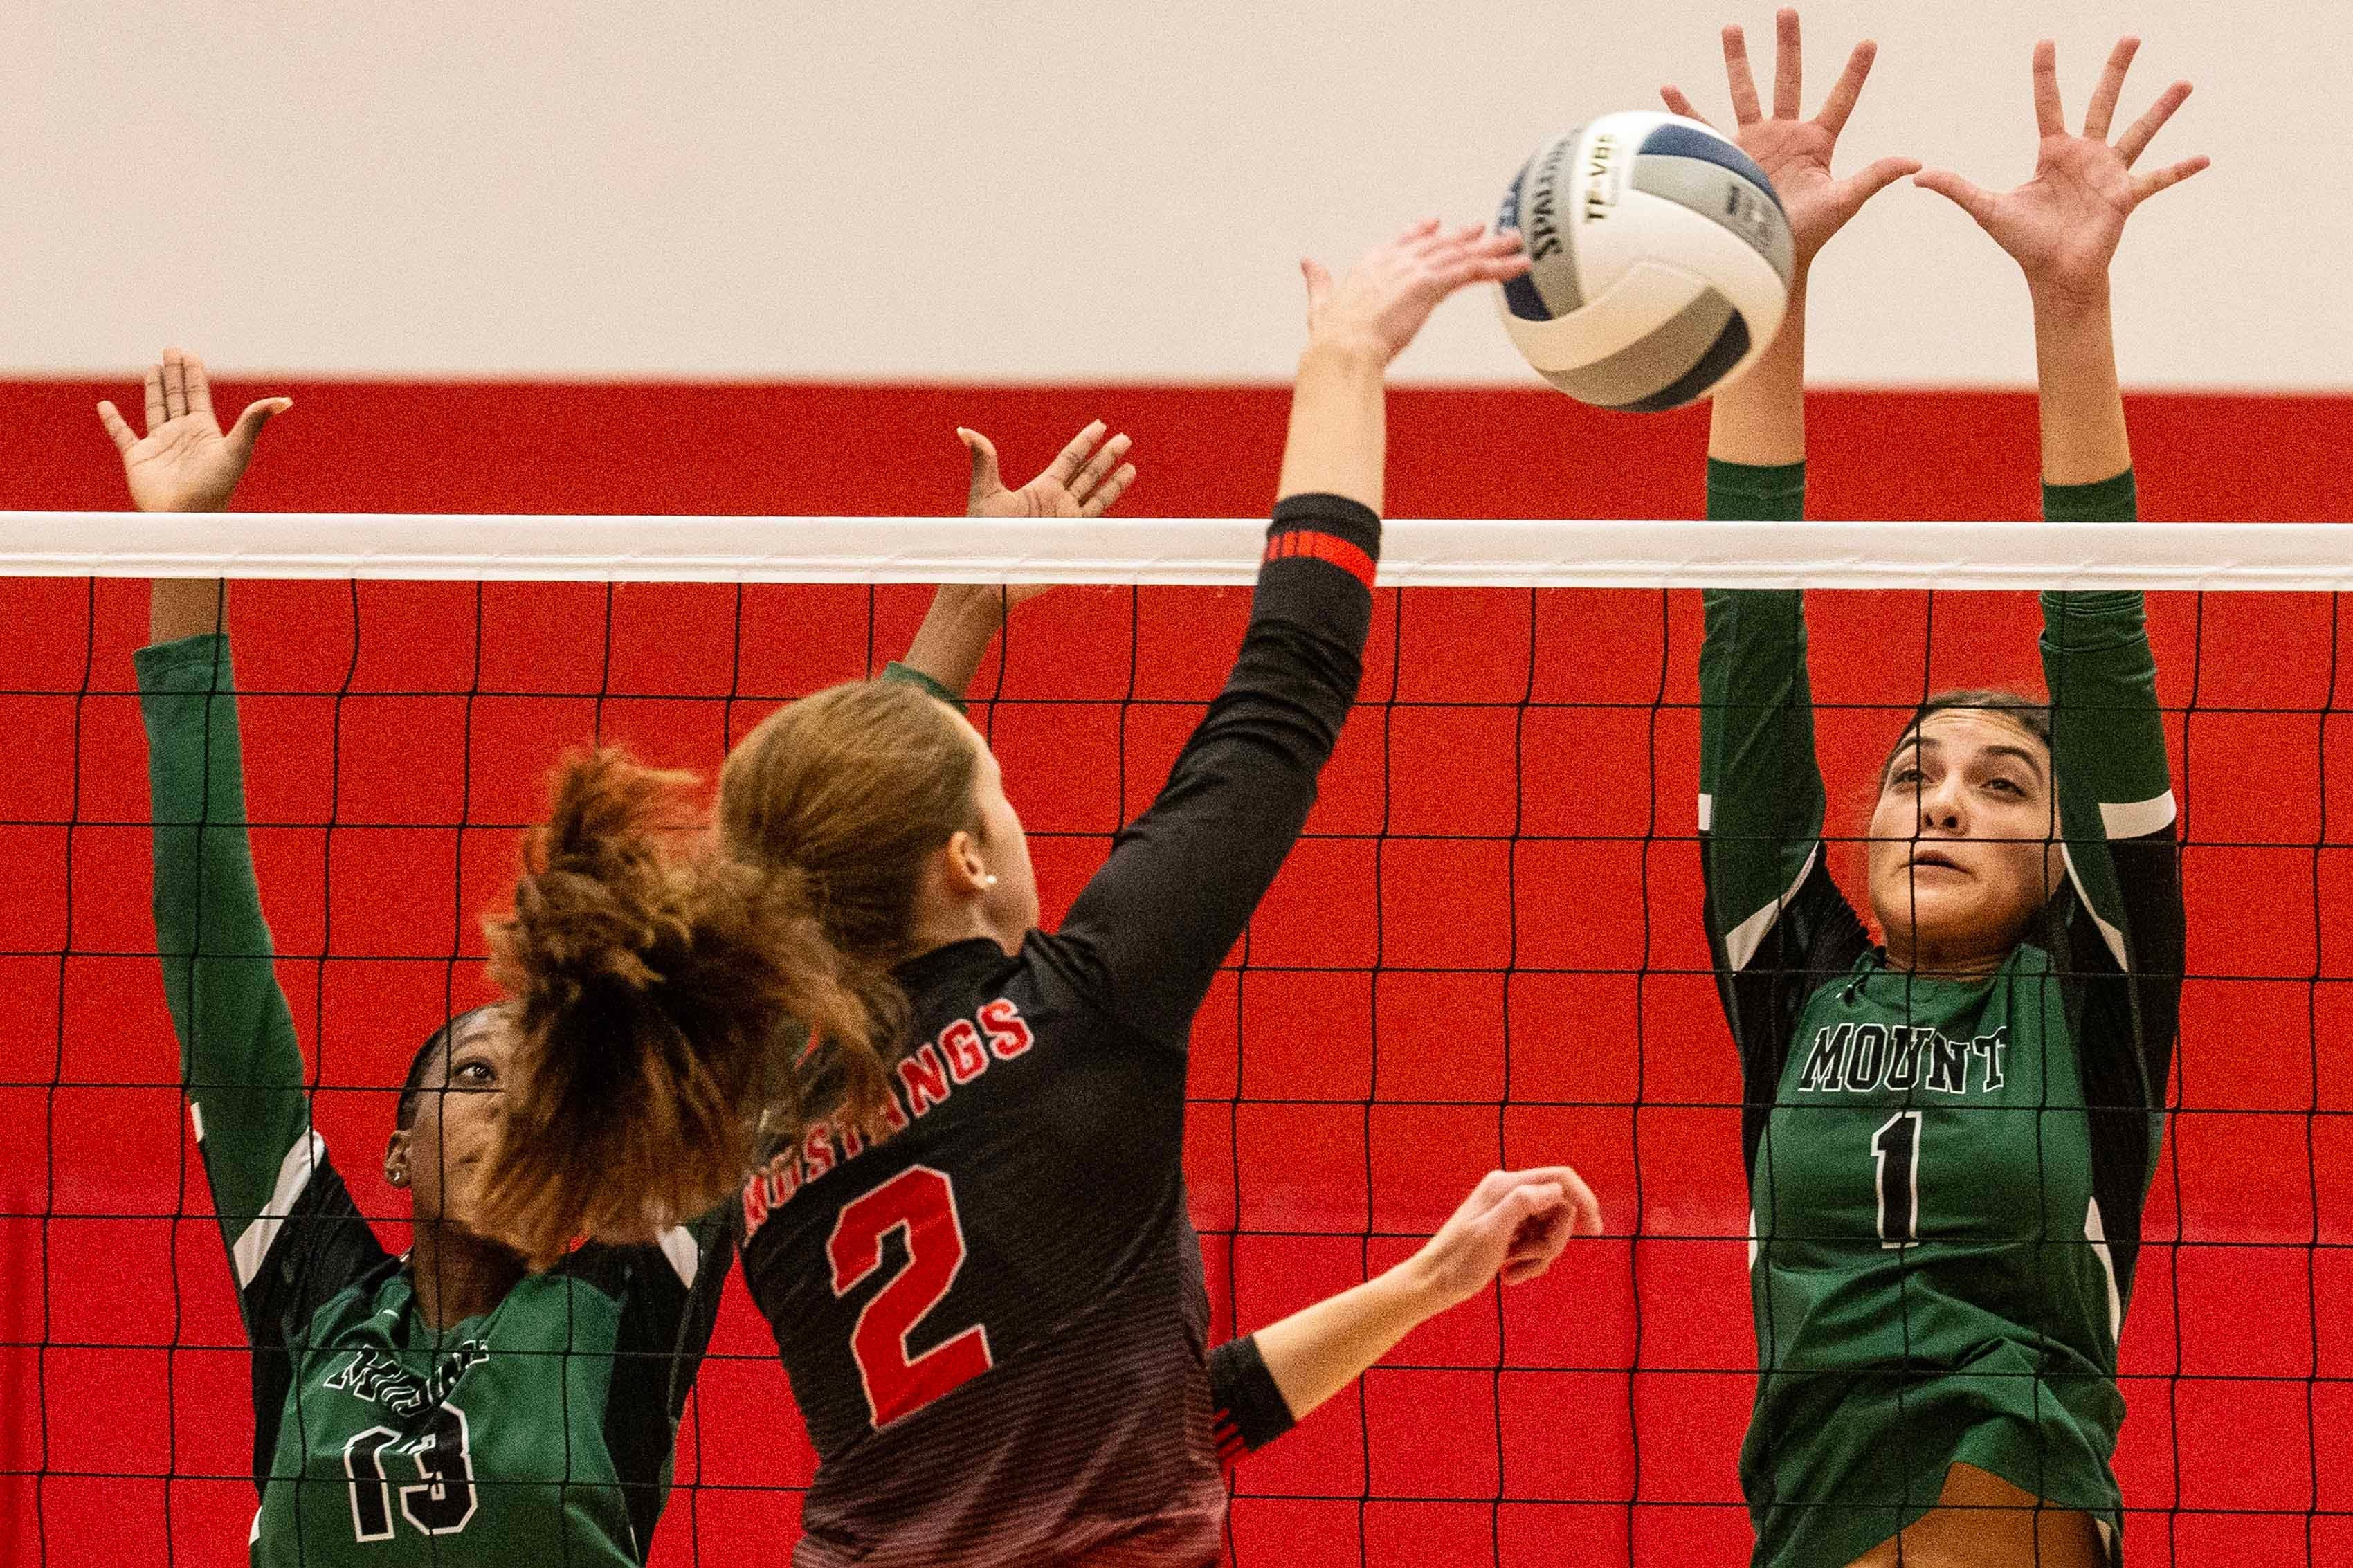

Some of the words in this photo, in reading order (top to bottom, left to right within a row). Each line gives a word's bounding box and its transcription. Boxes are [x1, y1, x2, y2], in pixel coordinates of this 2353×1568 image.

[1797, 1023, 2007, 1095] MOUNT
[1871, 1111, 1922, 1248] 1
[826, 1164, 994, 1432] 2
[342, 1401, 478, 1542] 13
